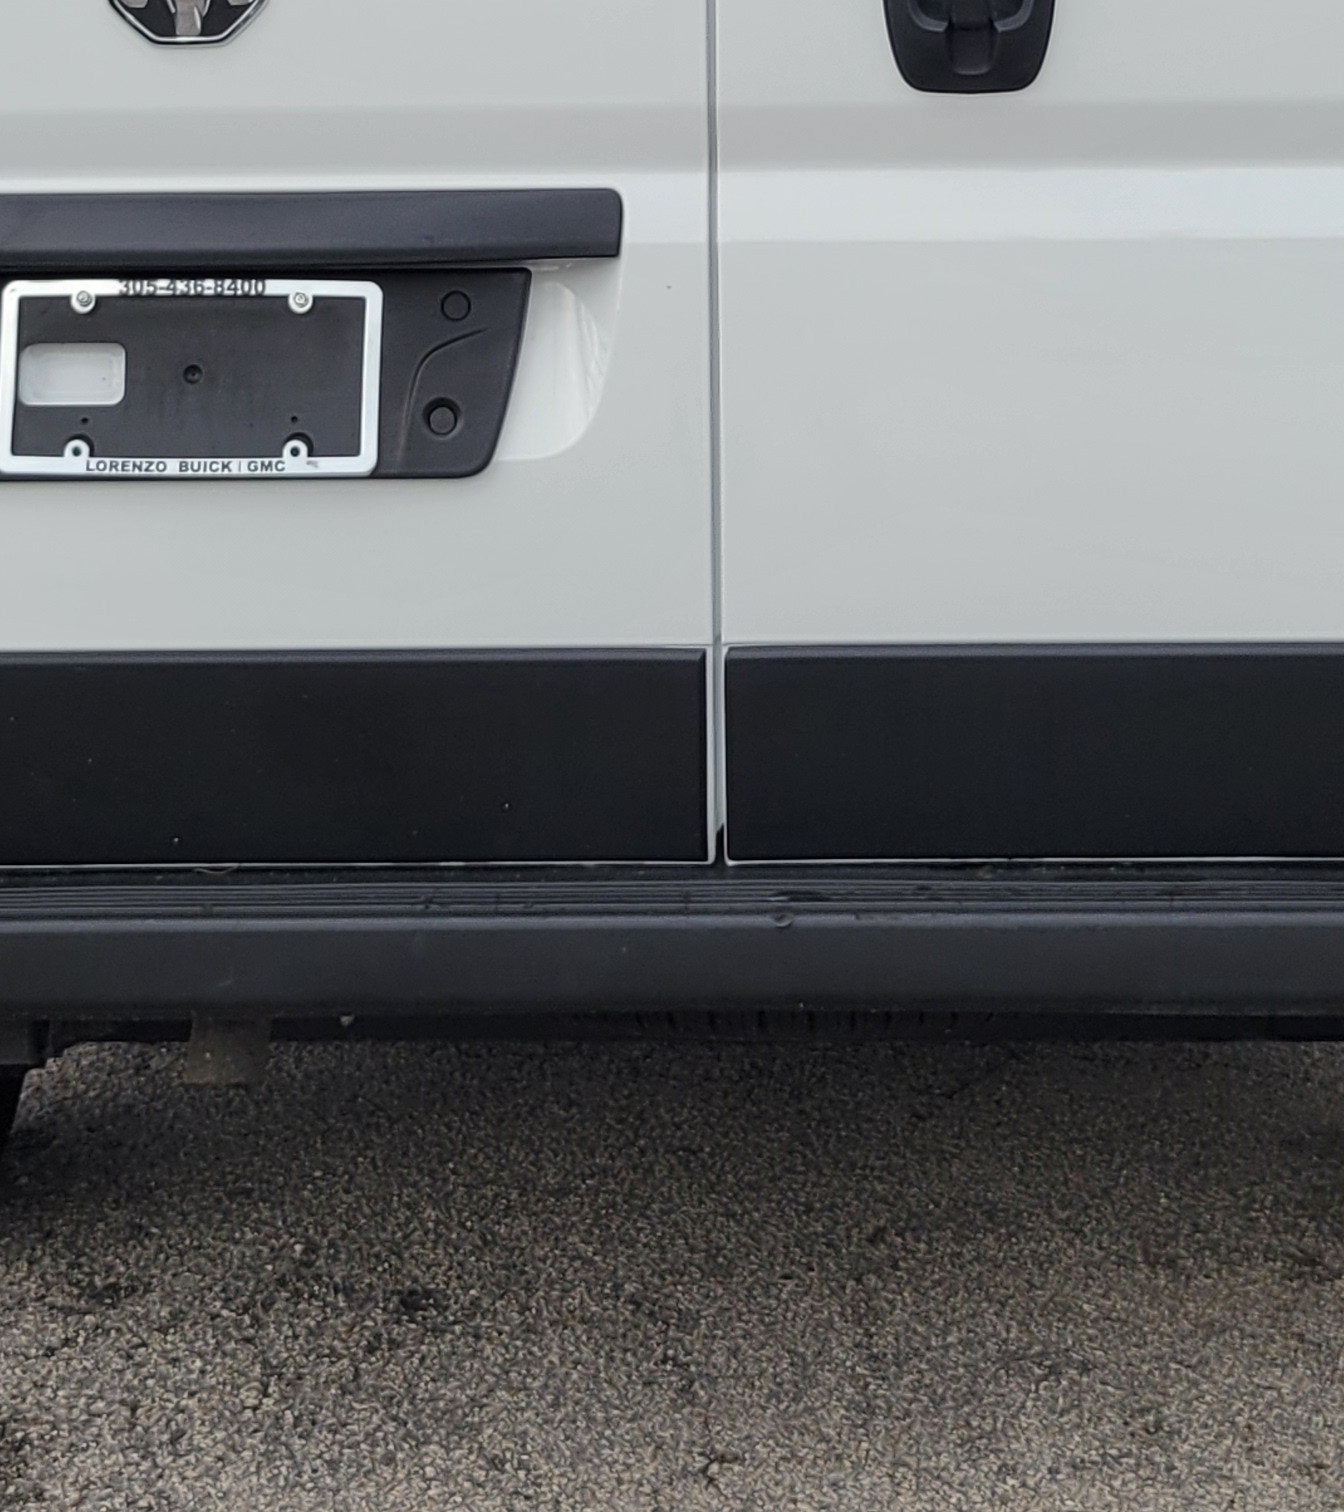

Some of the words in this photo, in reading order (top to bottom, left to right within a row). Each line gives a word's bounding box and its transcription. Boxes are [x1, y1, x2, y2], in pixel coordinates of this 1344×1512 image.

[85, 460, 168, 473] LORENZO
[178, 460, 232, 473] BUICK
[247, 459, 286, 473] GMC
